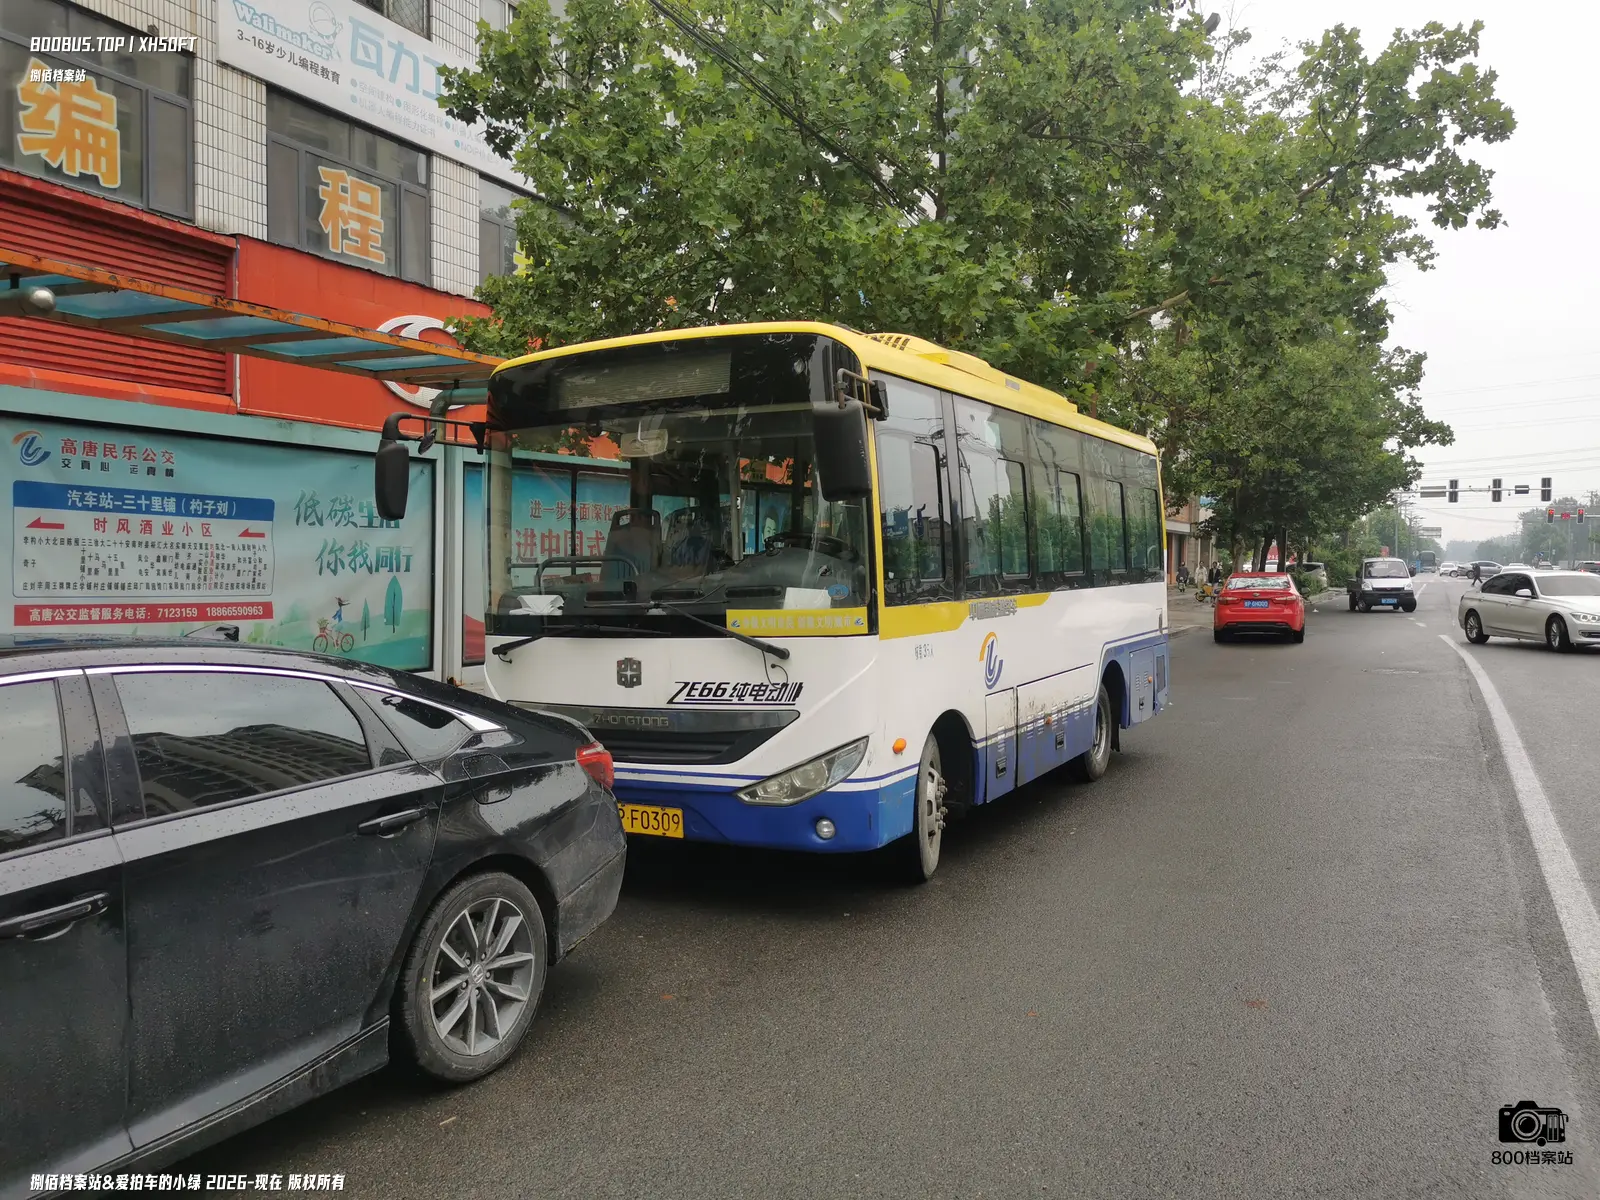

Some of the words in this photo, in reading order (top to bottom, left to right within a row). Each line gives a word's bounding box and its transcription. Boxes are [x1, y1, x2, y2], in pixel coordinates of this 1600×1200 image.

[237, 29, 340, 85] 3-16岁少儿编程教育
[17, 57, 121, 188] 编
[318, 165, 385, 264] 程
[60, 438, 175, 465] 高唐民乐公交
[93, 517, 213, 537] 时风酒业小区
[315, 538, 413, 576] 你我同行
[157, 606, 198, 618] 7123159
[206, 605, 264, 617] 18866590963
[593, 712, 669, 727] ZHONGTONG
